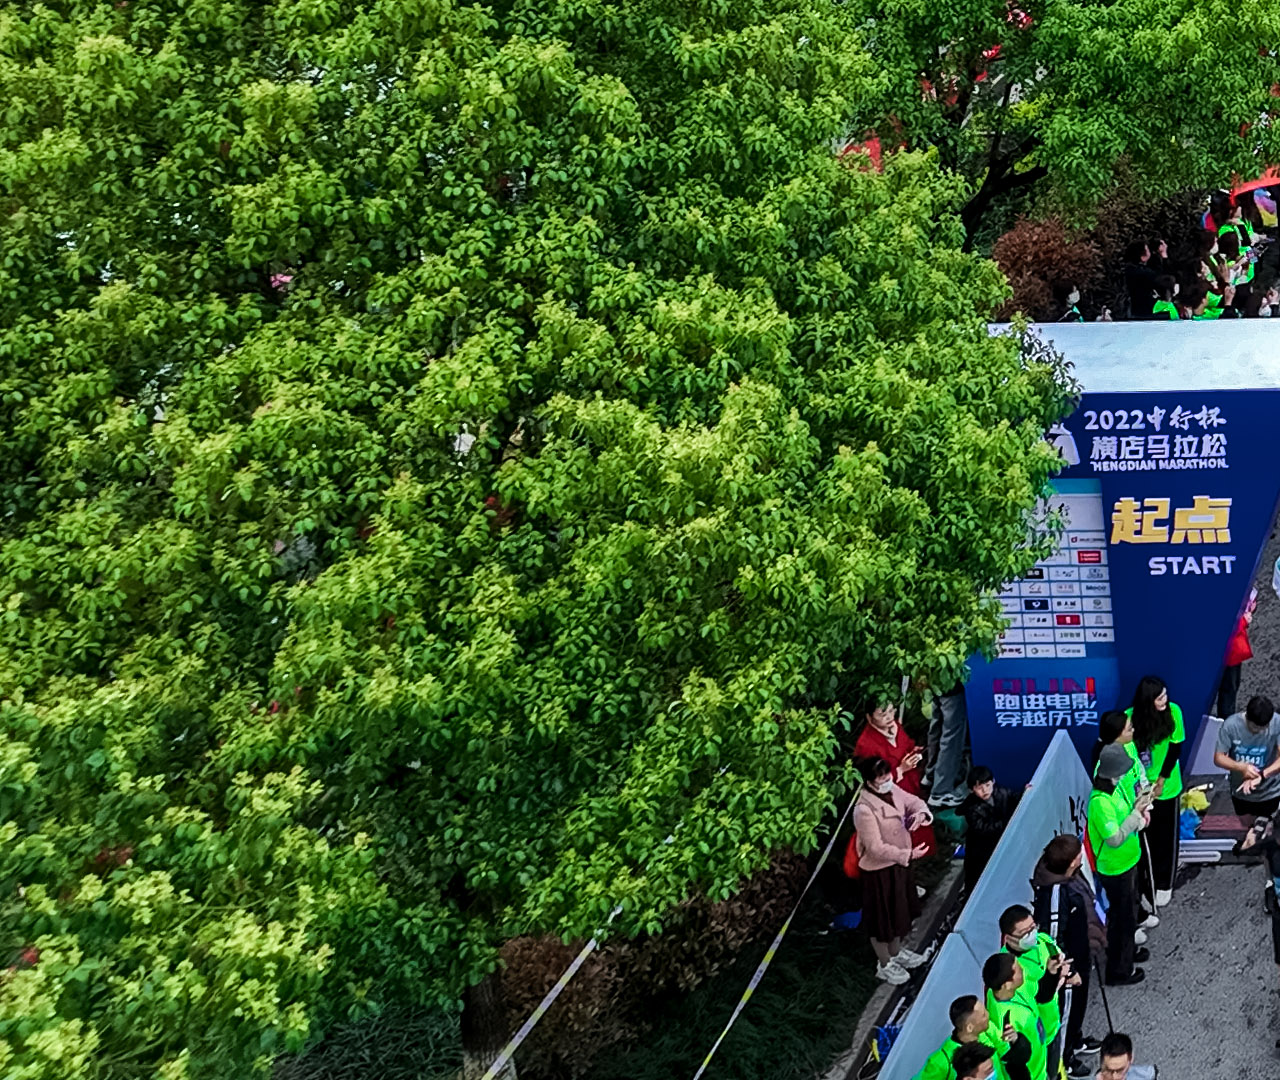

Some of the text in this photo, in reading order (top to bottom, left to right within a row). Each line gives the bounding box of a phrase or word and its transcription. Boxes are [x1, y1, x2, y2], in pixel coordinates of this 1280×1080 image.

[1085, 405, 1227, 432] 2022中行杯
[1089, 433, 1228, 460] 横店马拉松
[1090, 460, 1156, 472] HENGDIAN
[1111, 495, 1233, 545] 起点
[1148, 556, 1236, 576] START
[994, 693, 1097, 709] 跑进电影
[996, 711, 1098, 727] 穿越历史
